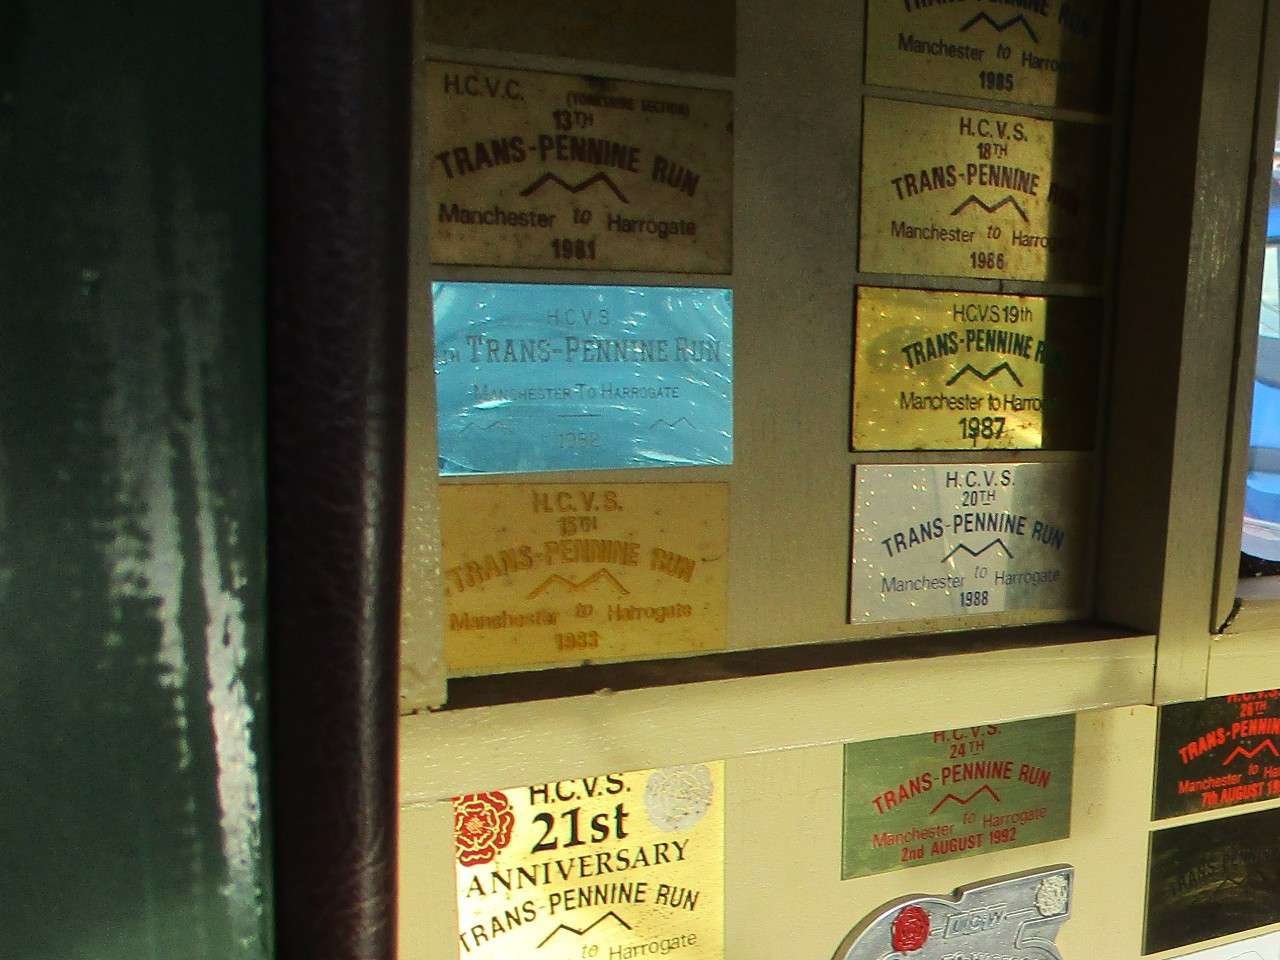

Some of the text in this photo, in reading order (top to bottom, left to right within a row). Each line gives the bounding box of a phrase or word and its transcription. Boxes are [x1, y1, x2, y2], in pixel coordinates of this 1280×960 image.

[899, 33, 1062, 72] Manchester to Harro
[960, 117, 1028, 142] H.C.V.S.
[651, 155, 700, 198] RUN
[438, 203, 697, 241] Manchester to Harrogate
[891, 221, 1054, 250] Manchester to Harro
[552, 238, 597, 260] 1981
[970, 252, 1006, 270] 1986
[1002, 303, 1033, 323] 19th
[676, 340, 721, 364] RUN
[601, 384, 681, 400] HARROGATE
[900, 391, 1044, 412] Manchester to Harro
[958, 416, 1006, 441] 1987
[946, 469, 1015, 489] H.C.V.S.
[961, 489, 996, 507] 20TH
[881, 512, 1065, 558] TRANS-PENNINE RUN
[650, 547, 697, 584] RUN
[881, 565, 1061, 593] Manchester to Harrogate
[960, 590, 989, 607] 1988
[449, 601, 692, 632] Manchester to Harrogate
[529, 773, 631, 806] H.C.V.S.
[871, 761, 1052, 816] TRANS-PENNINE RUN
[1178, 772, 1242, 794] Manchester
[1248, 763, 1259, 776] to
[1220, 783, 1264, 805] AUGUST
[530, 802, 630, 855] 21st
[872, 806, 1048, 849] Manchester to Harrogate
[901, 827, 1017, 863] 2nd AUGUST 1992
[466, 838, 689, 898] ANNIVERSARY
[459, 881, 700, 953] TRANS-PENNINE RUN
[581, 943, 598, 959] to
